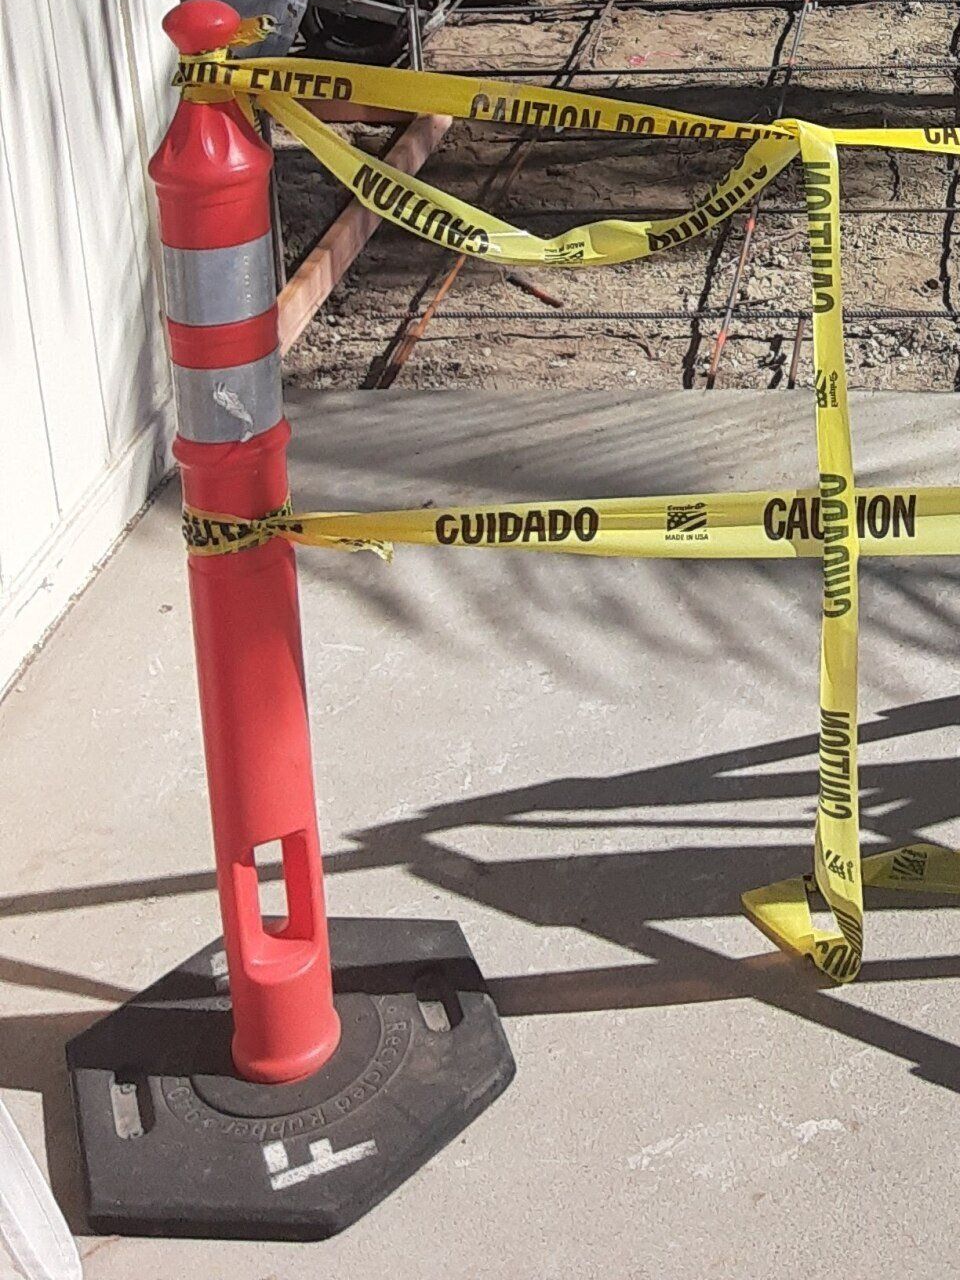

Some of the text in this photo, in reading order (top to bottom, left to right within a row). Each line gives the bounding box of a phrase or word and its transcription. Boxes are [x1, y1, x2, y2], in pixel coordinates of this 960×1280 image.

[353, 163, 490, 255] CAUTION
[435, 506, 600, 545] CUIDADO
[694, 533, 709, 541] USA
